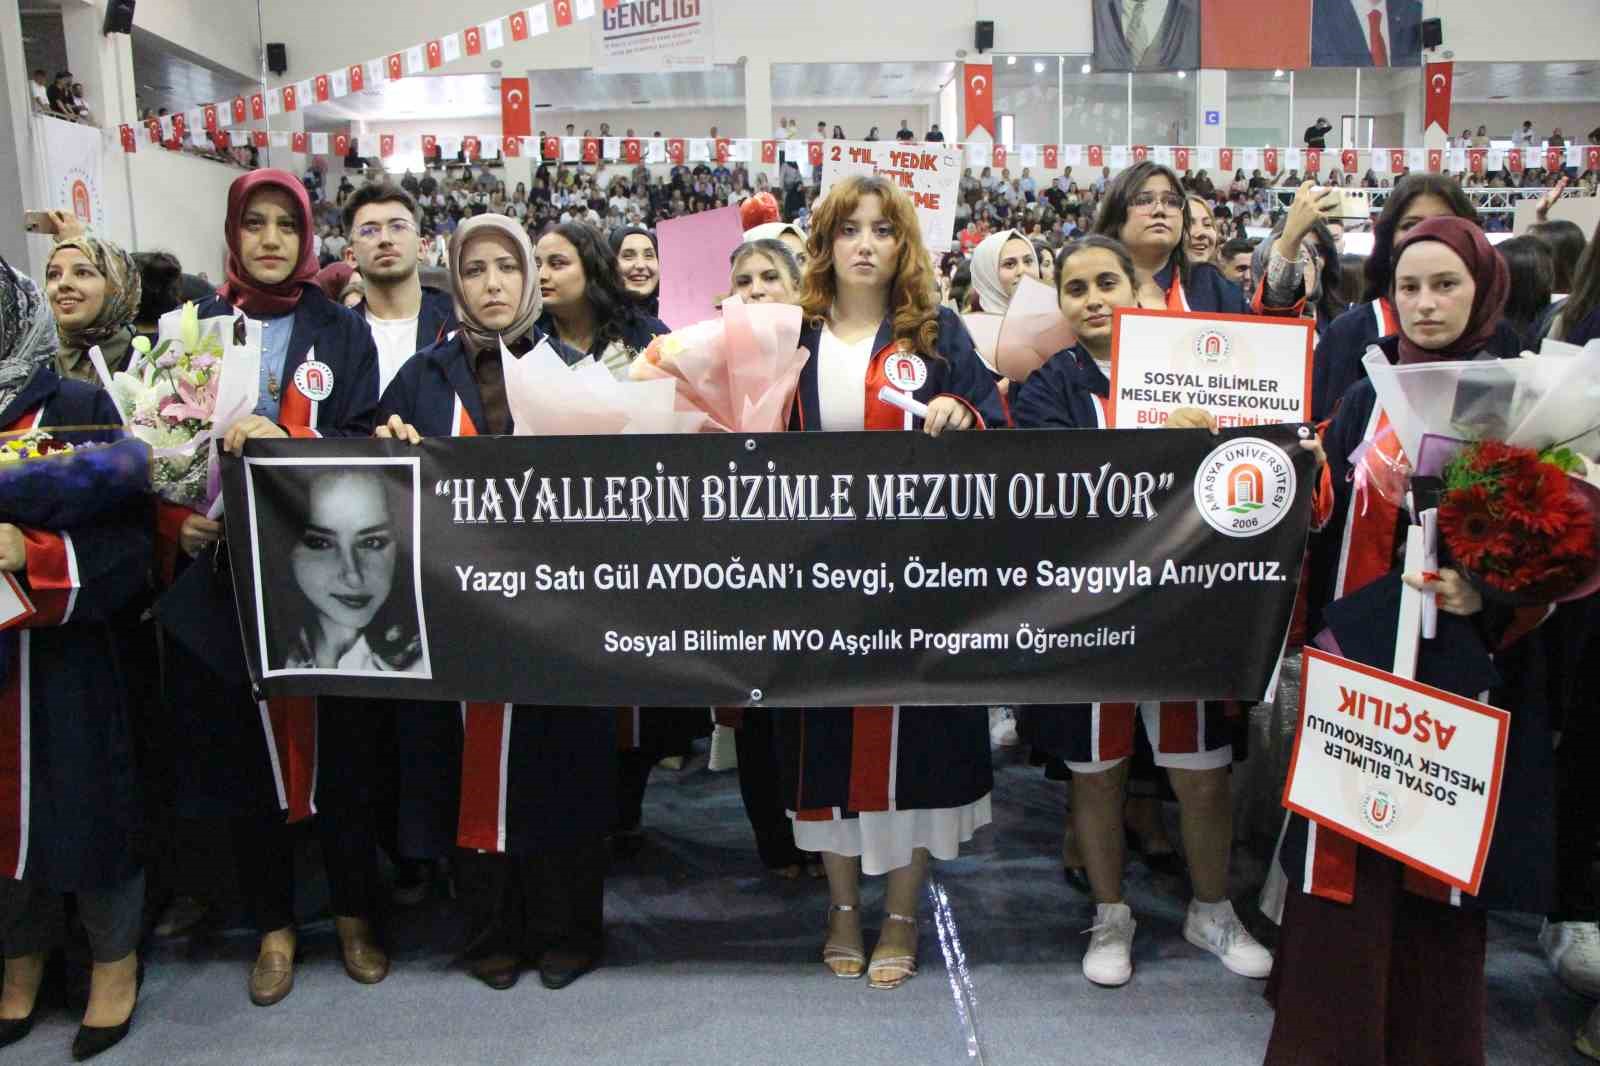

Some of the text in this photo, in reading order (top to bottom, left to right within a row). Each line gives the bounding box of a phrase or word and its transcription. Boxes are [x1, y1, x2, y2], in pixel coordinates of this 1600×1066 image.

[831, 145, 842, 161] 2
[889, 150, 938, 171] YEDİK
[873, 165, 914, 188] İTİK
[1121, 387, 1300, 411] MESLEK YÜKSEKOKULU
[1144, 372, 1279, 393] SOSYAL BİLİMLER
[701, 461, 856, 521] BİZİMLE
[865, 473, 998, 521] MEZUN
[1204, 462, 1224, 511] AMASYA
[1232, 517, 1258, 529] 2006
[455, 565, 526, 598] Yazgı
[535, 564, 585, 591] Satı
[594, 563, 639, 590] Gül
[811, 562, 895, 596] Sevgi,
[903, 555, 988, 589] Özlem
[996, 566, 1027, 588] ve
[1036, 559, 1153, 596] Saygıyla
[1159, 557, 1287, 590] Anıyoruz.
[604, 624, 1137, 657] Sosyal Bilimler MYO Aşçılık Programı Öğrencileri
[1337, 686, 1457, 750] AŞÇILIK
[1307, 715, 1486, 796] MESLEK YÜKSEKOKULU
[1324, 740, 1457, 806] SOSYAL BİLİMLER
